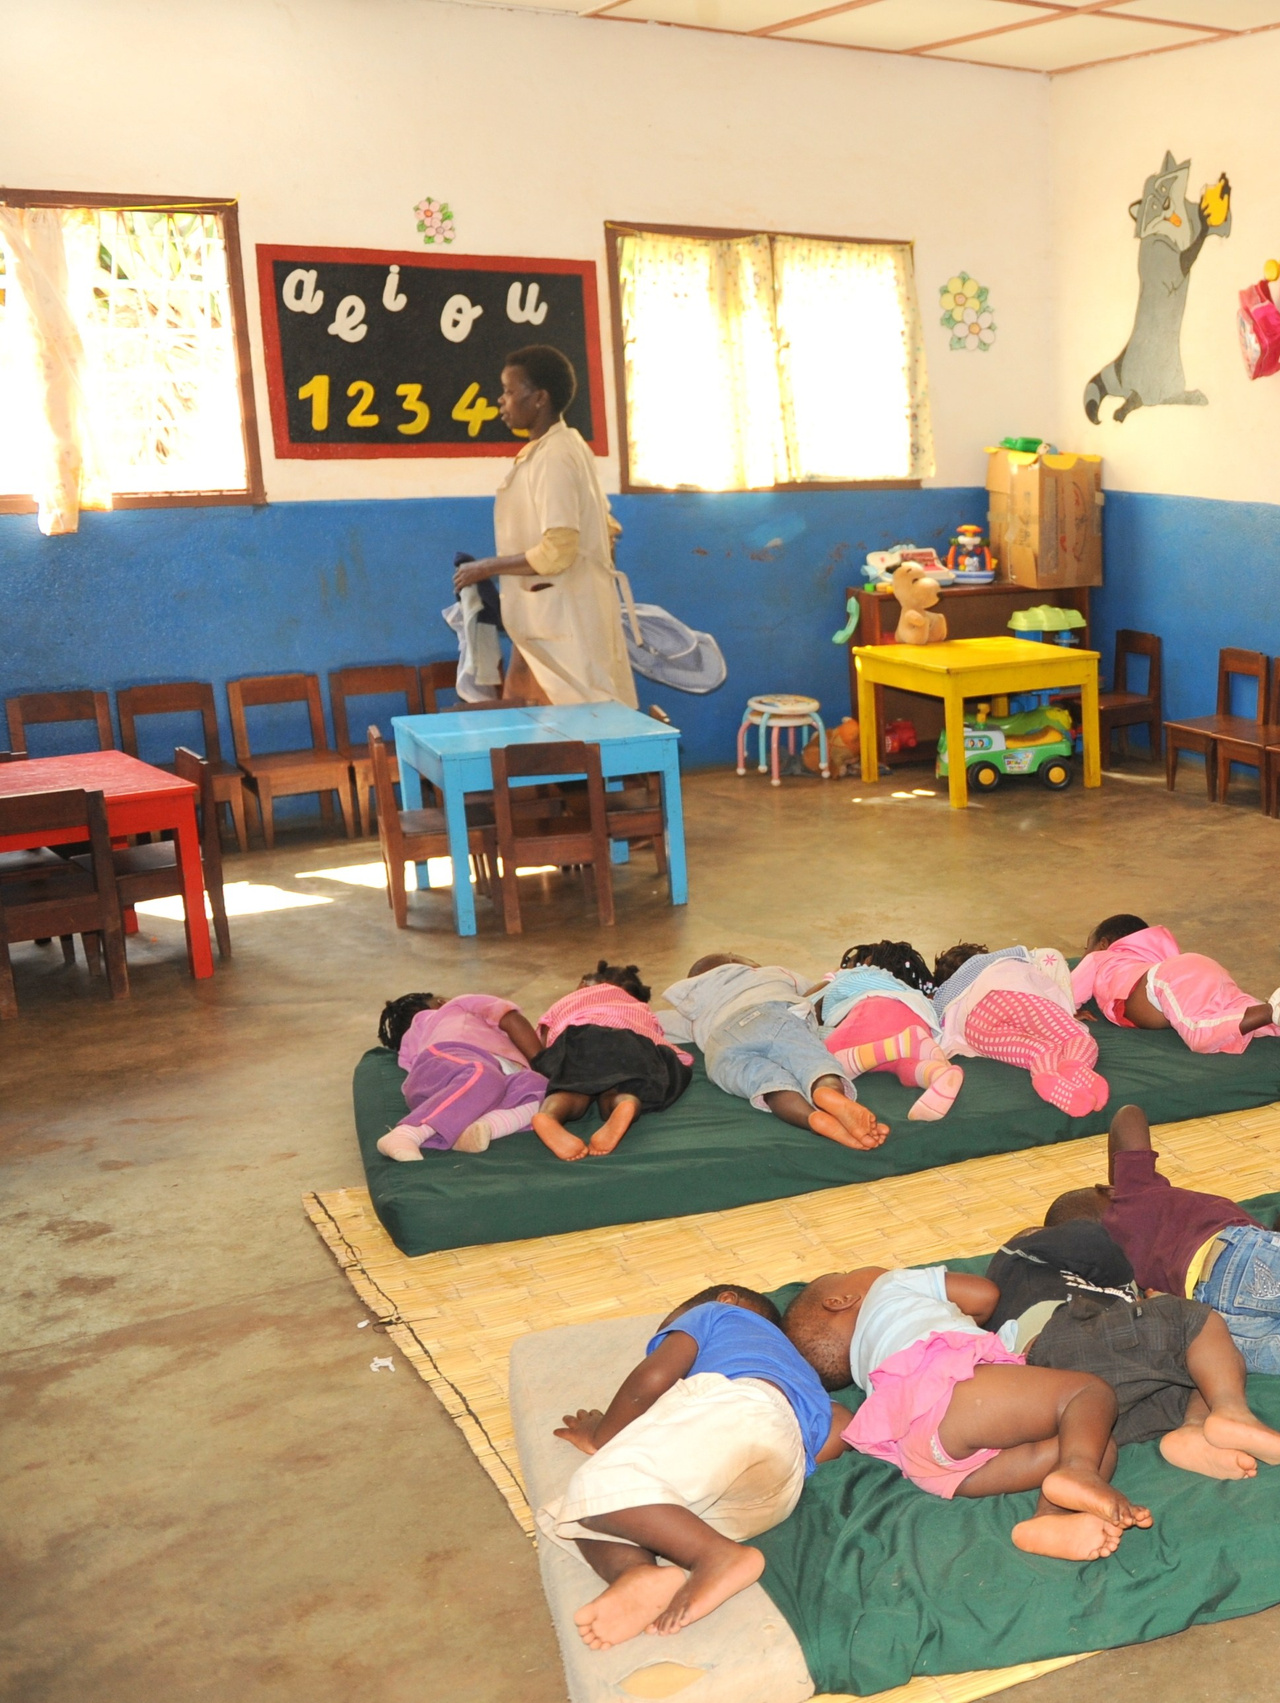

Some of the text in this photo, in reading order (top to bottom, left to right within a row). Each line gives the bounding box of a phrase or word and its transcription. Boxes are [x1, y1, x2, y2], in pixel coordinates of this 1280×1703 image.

[281, 264, 548, 343] a e i o u
[298, 374, 498, 437] 1 2 3 4
